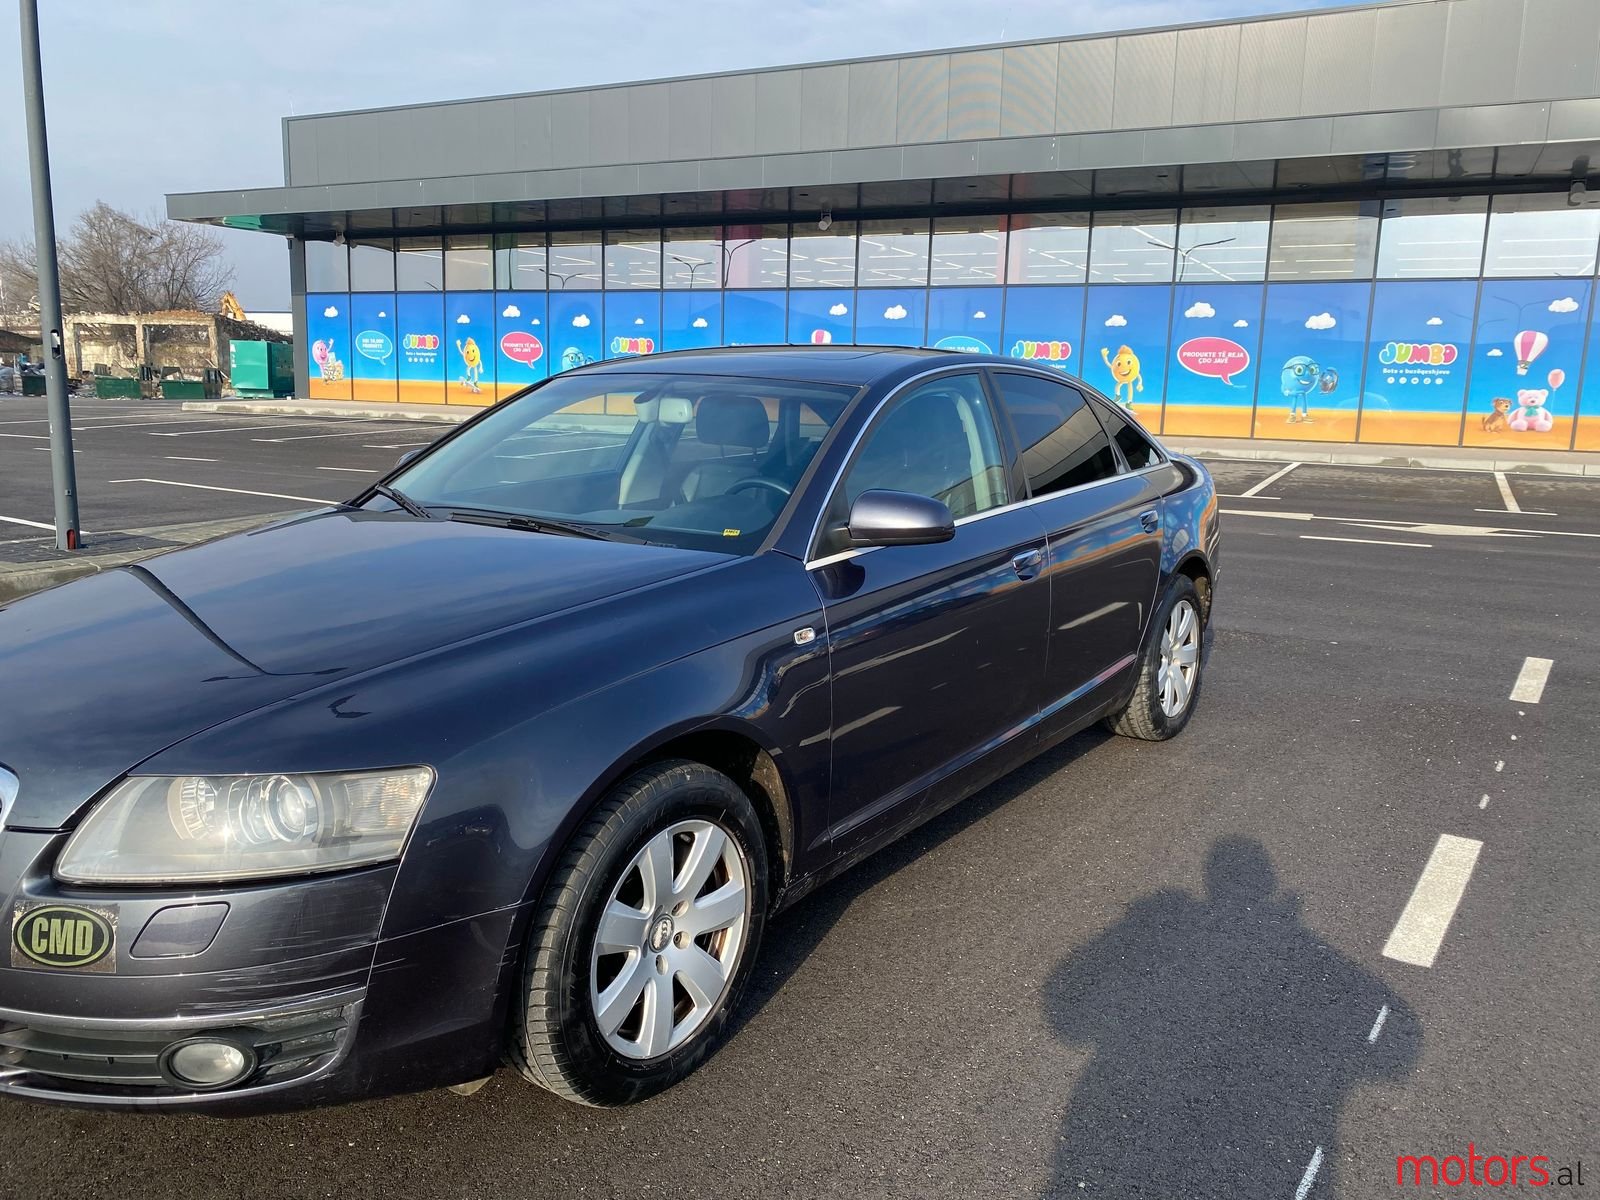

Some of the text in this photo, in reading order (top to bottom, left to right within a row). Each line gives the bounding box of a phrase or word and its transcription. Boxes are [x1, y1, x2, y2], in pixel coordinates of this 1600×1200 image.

[403, 334, 440, 350] JUMBO
[611, 336, 654, 354] JUMBO
[1011, 340, 1071, 360] JUMBO
[1218, 350, 1226, 358] TË
[1379, 342, 1458, 365] JUMBO
[31, 917, 94, 956] CMD
